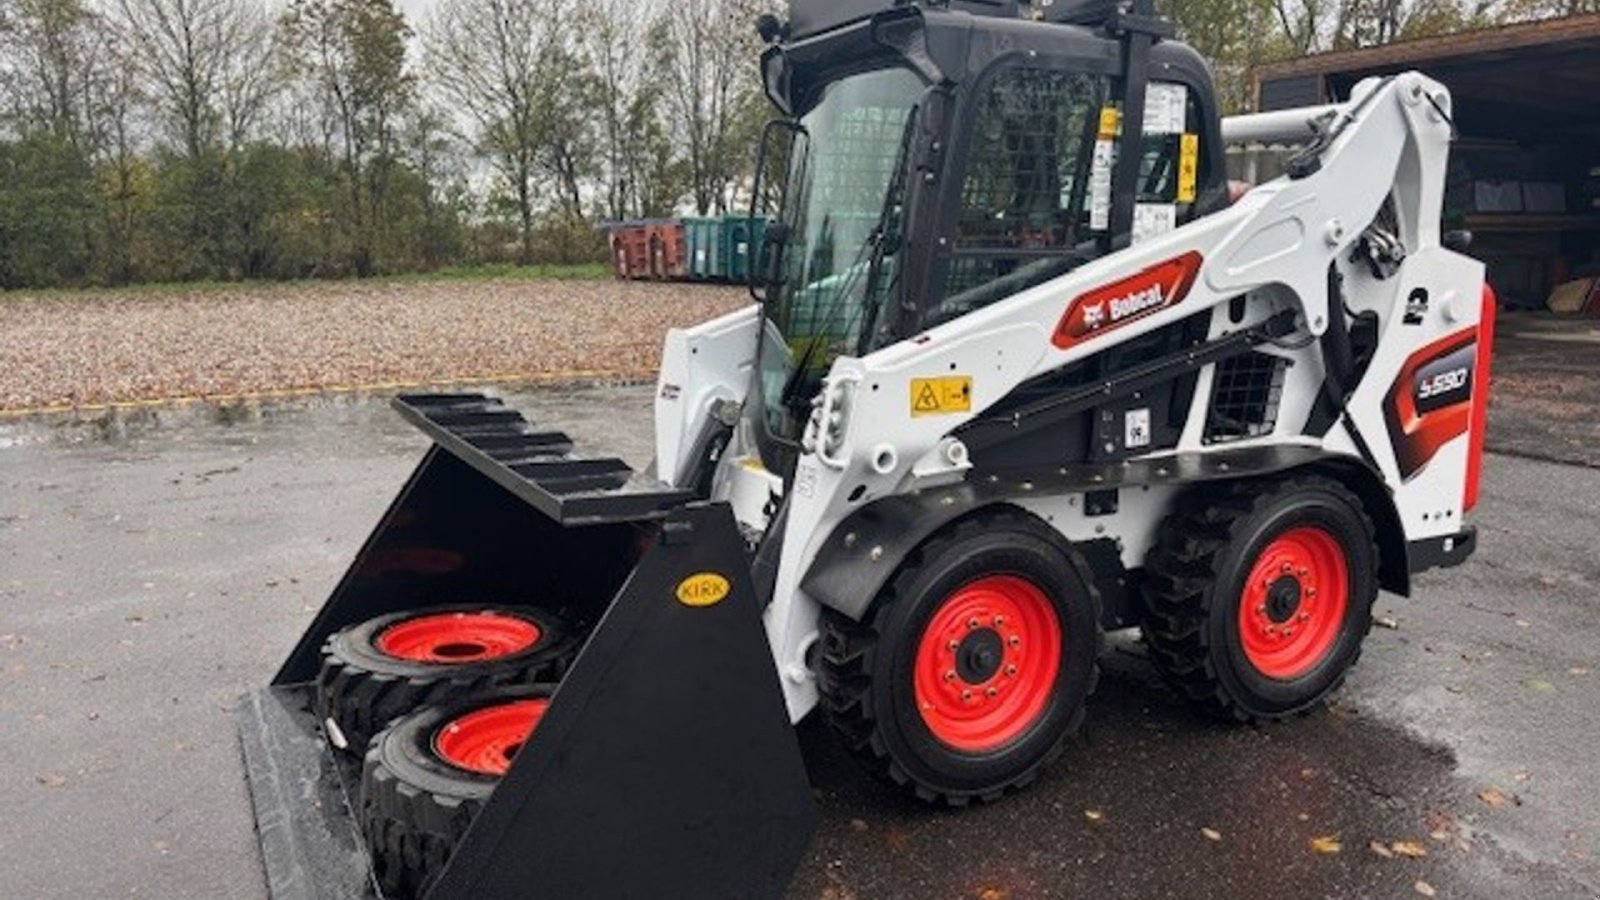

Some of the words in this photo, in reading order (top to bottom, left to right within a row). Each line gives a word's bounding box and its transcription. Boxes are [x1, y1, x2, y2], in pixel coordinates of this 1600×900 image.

[1109, 283, 1162, 320] Bobcat
[1419, 368, 1467, 398] S590
[682, 580, 725, 599] KIRK
